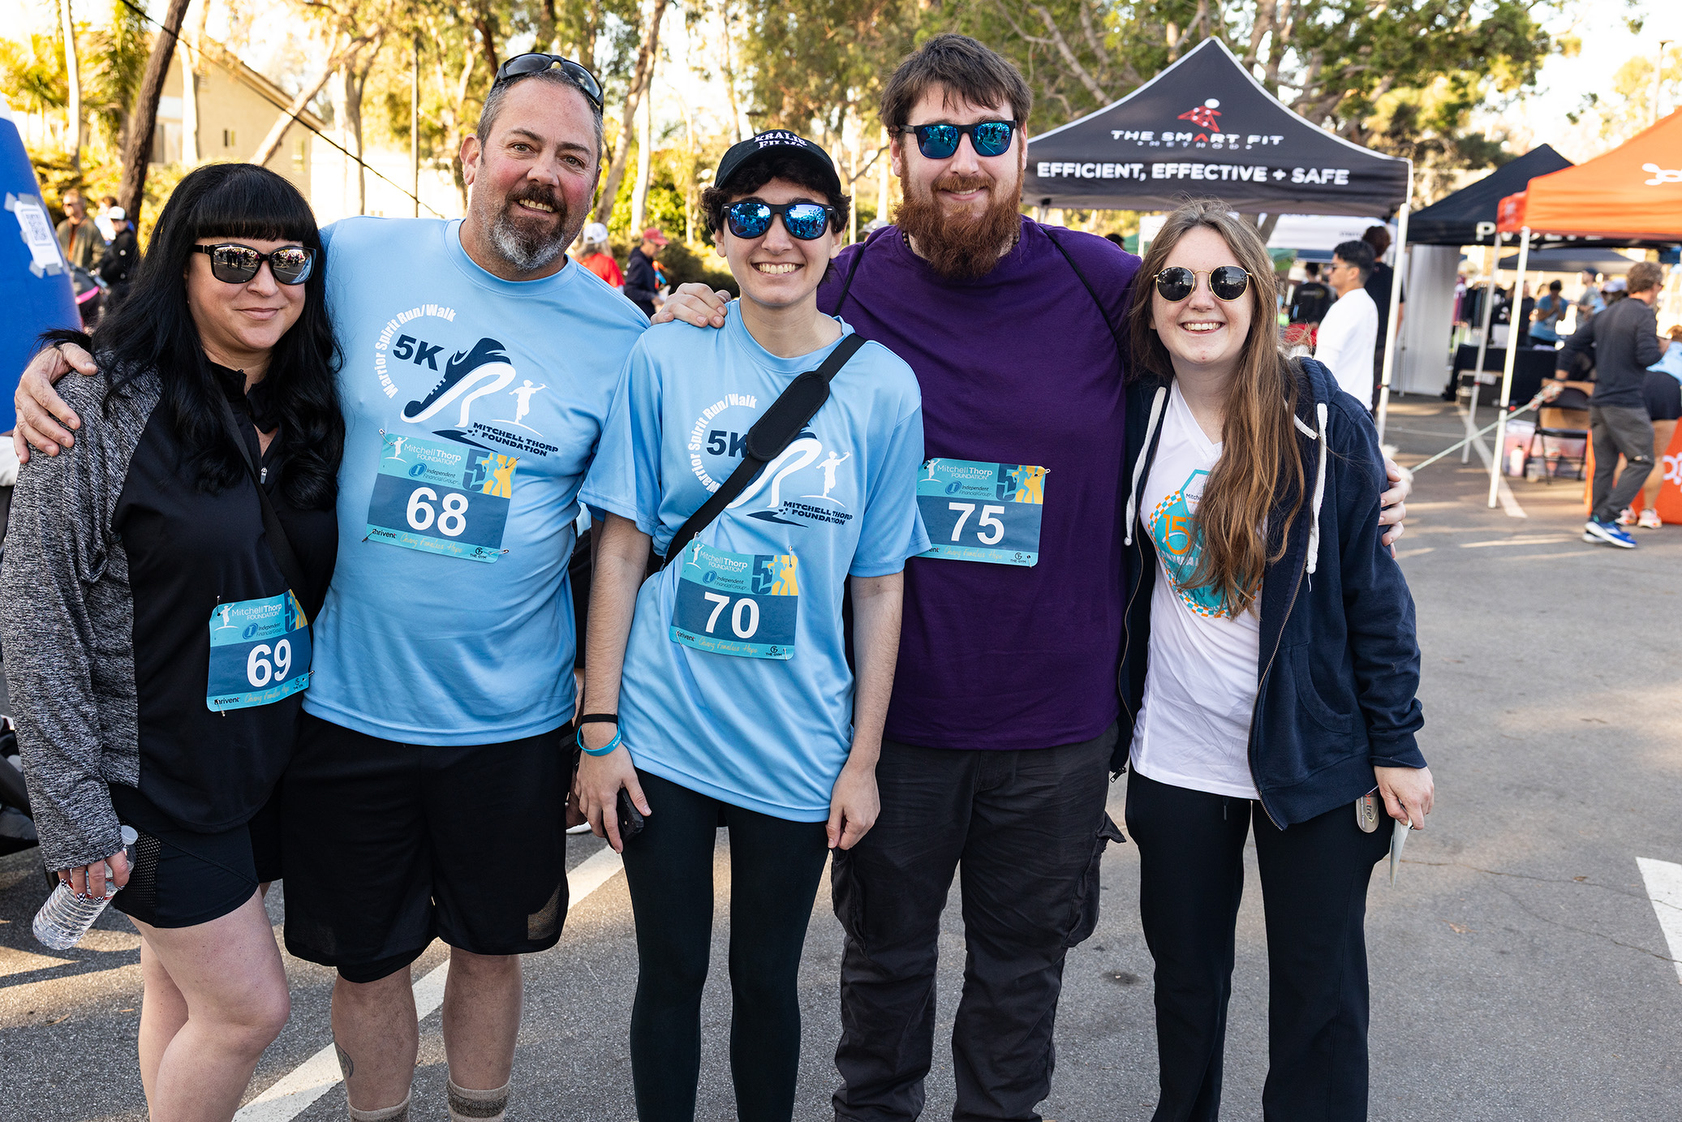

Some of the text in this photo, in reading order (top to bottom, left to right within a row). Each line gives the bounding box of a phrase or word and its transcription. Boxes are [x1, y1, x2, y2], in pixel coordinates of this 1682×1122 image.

[1110, 129, 1285, 146] THE SMART FIT
[1037, 161, 1147, 182] EFFICIENT,
[1151, 162, 1268, 183] EFFECTIVE
[1290, 167, 1350, 186] SAFE
[374, 303, 457, 399] Warrior Spirit Run/Walk
[393, 333, 445, 372] 5K
[473, 422, 559, 453] MITCHELL THORP
[481, 432, 548, 457] FOUNDATION
[688, 393, 757, 493] Warrior Spirit Run/Walk
[706, 430, 750, 458] 5K
[416, 453, 457, 466] FOUNDATION
[426, 468, 456, 479] Independent
[951, 472, 988, 481] FOUNDATION
[406, 486, 469, 537] 68
[783, 501, 832, 515] MITCHELL
[948, 502, 1005, 545] 75
[708, 561, 743, 573] FOUNDATION
[716, 575, 744, 585] Independent
[246, 611, 280, 621] FOUNDATION
[704, 591, 760, 639] 70
[246, 638, 292, 688] 69
